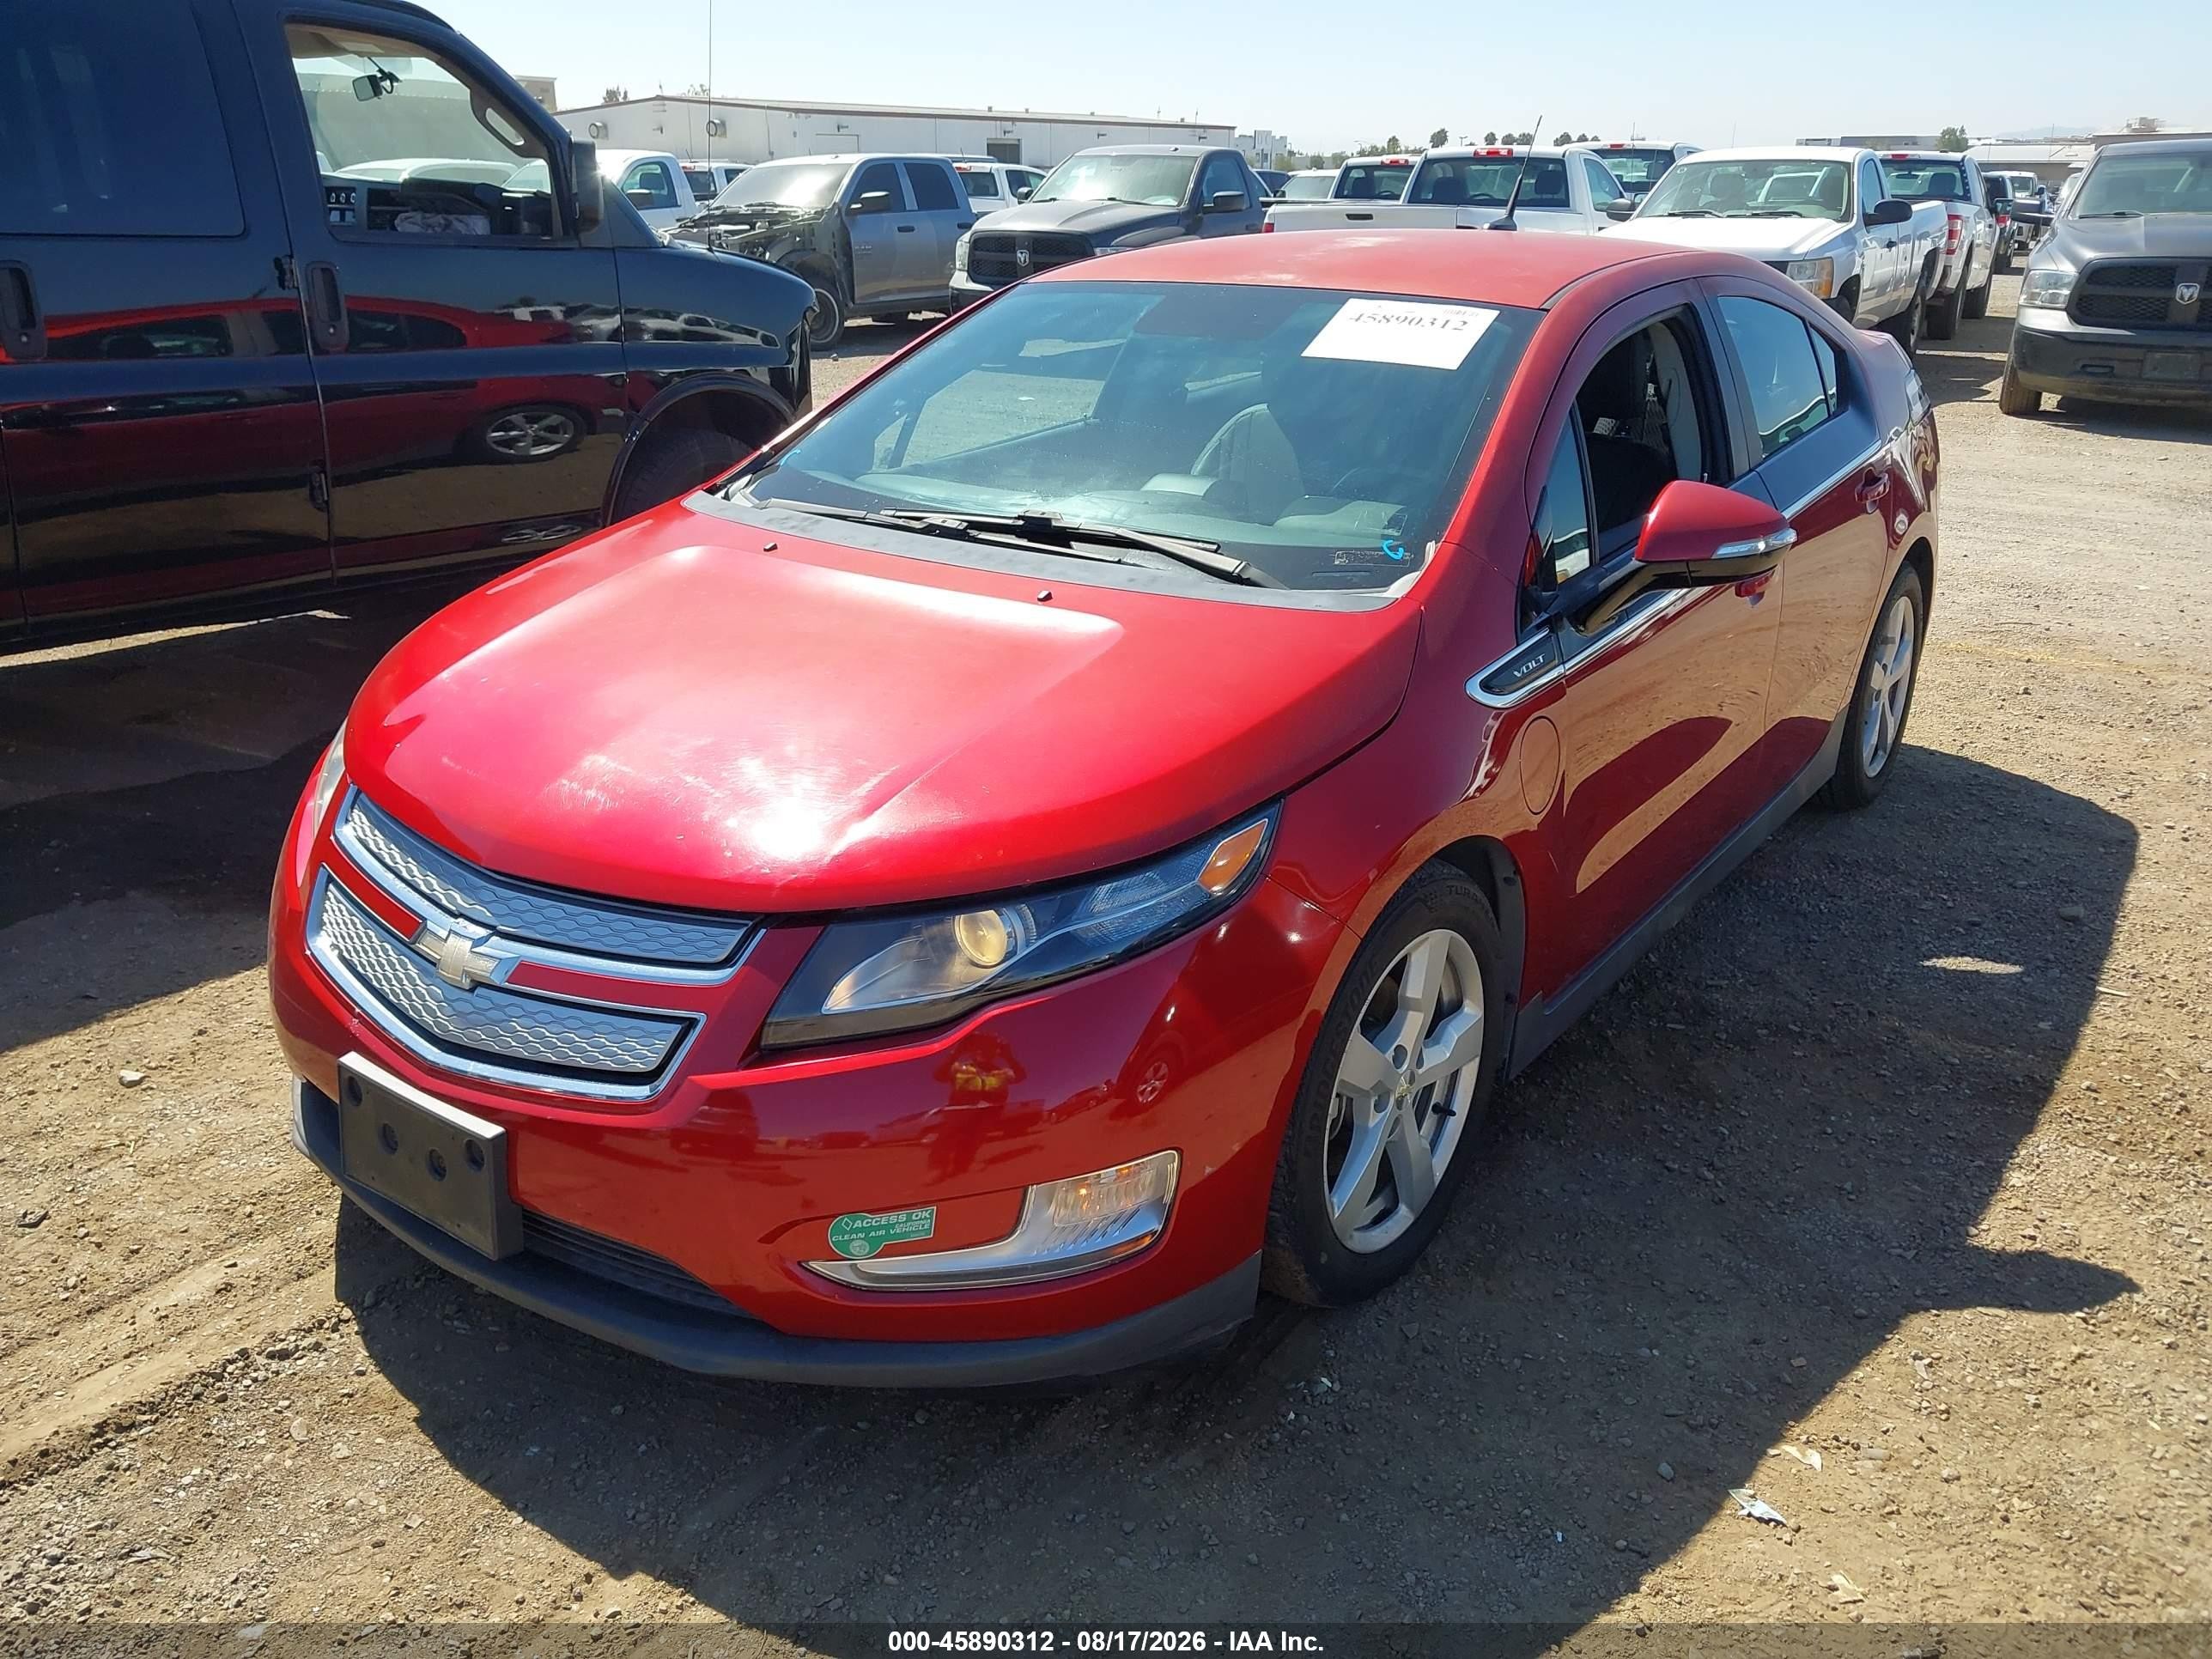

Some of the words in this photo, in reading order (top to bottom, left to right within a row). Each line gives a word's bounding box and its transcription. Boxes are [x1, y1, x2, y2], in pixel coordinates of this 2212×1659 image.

[1348, 312, 1469, 331] 45890312
[1513, 653, 1546, 678] VOLT
[853, 1213, 907, 1229] ACCESS
[912, 1210, 932, 1219] OK
[895, 1218, 931, 1229] CALIFORNIA
[832, 1232, 866, 1242] CLEAN
[868, 1229, 886, 1237] AIR
[890, 1223, 931, 1235] VEHICLE
